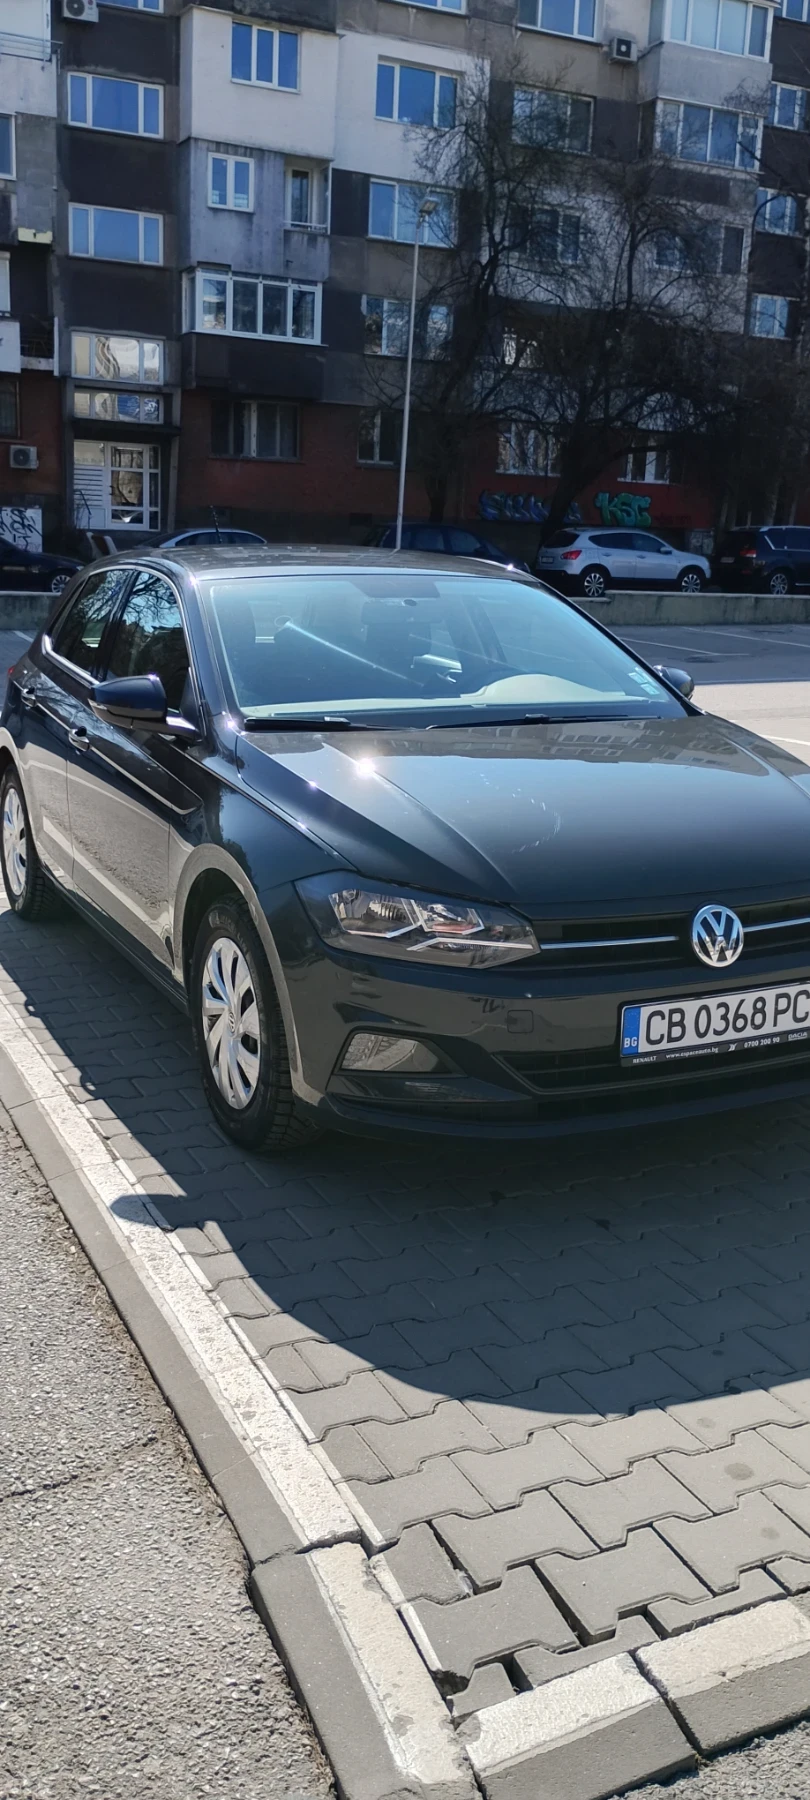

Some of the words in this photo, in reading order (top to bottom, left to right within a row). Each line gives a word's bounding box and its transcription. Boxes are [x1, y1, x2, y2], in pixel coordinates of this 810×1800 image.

[693, 905, 743, 967] VW
[645, 1008, 687, 1046] CB
[694, 997, 767, 1039] 0368
[773, 990, 810, 1028] PC
[624, 1036, 638, 1048] BG
[744, 1040, 759, 1049] 0700
[760, 1038, 771, 1047] 200
[772, 1036, 781, 1044] 90
[788, 1032, 808, 1041] DACIA
[633, 1056, 658, 1065] RENAULT
